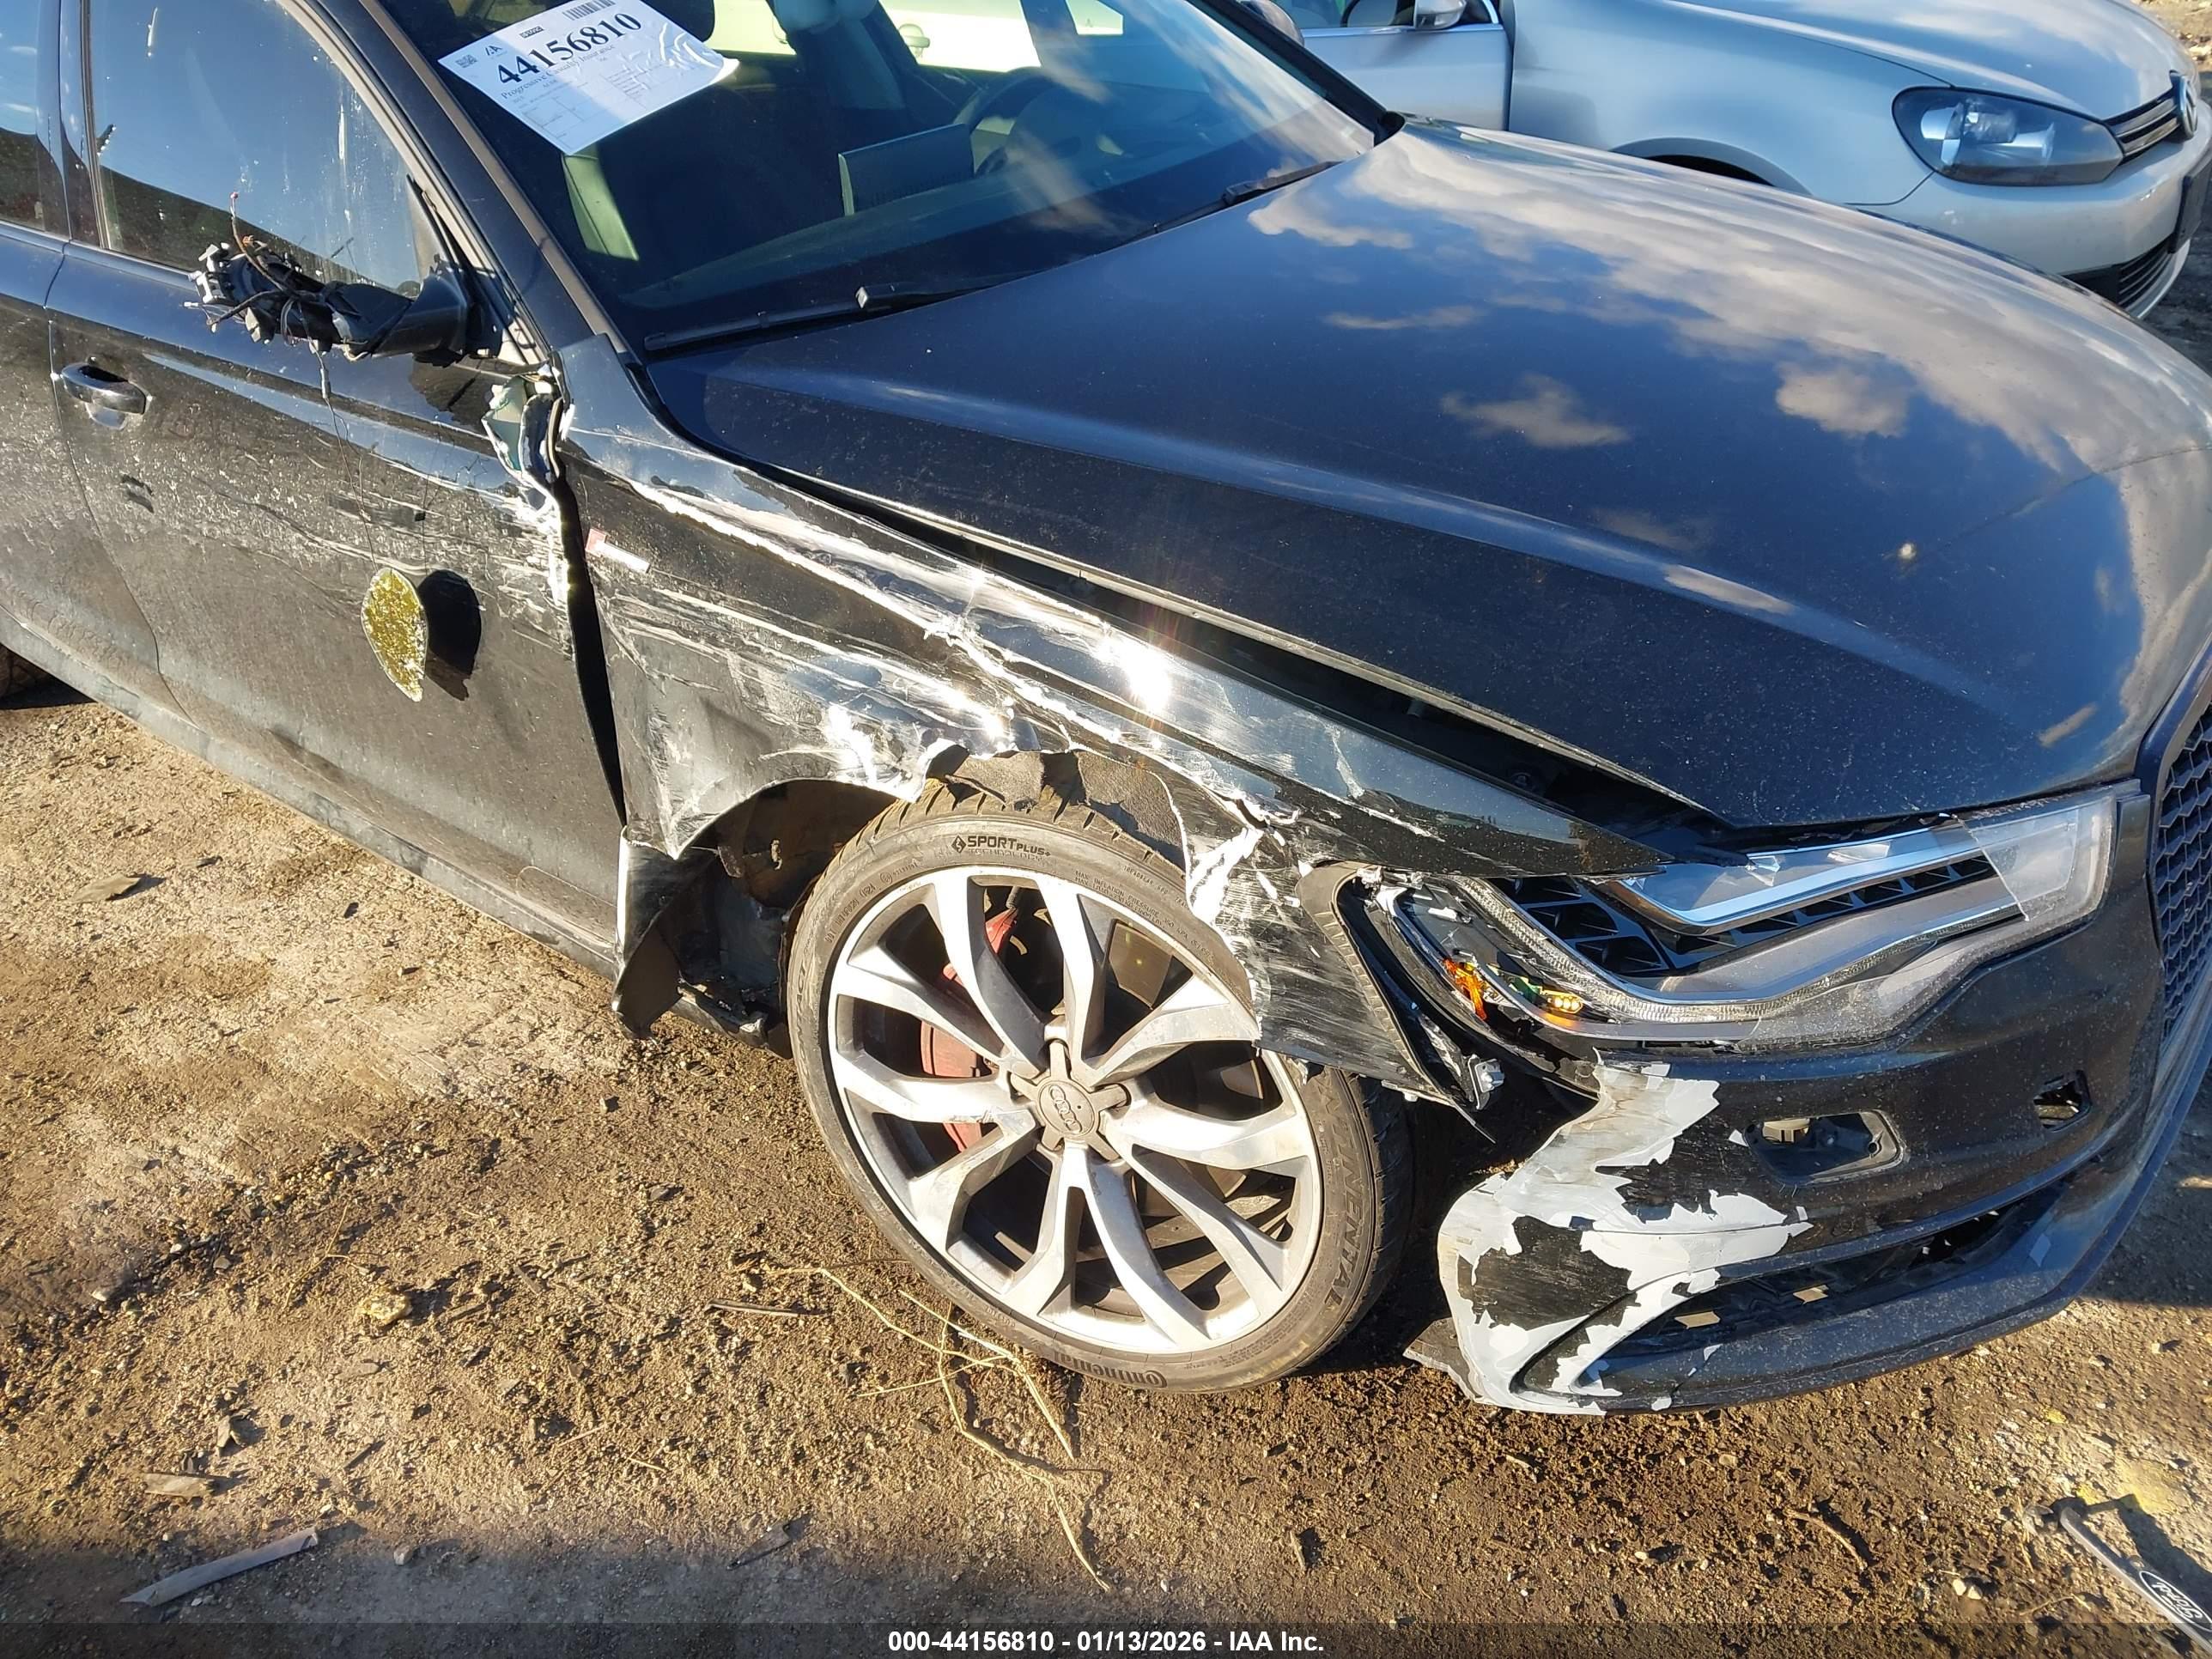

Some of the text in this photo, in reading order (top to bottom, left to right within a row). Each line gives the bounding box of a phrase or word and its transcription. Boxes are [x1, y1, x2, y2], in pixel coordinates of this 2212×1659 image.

[498, 13, 641, 83] 44156810
[501, 74, 547, 99] Progressive
[2150, 1581, 2203, 1620] Ford
